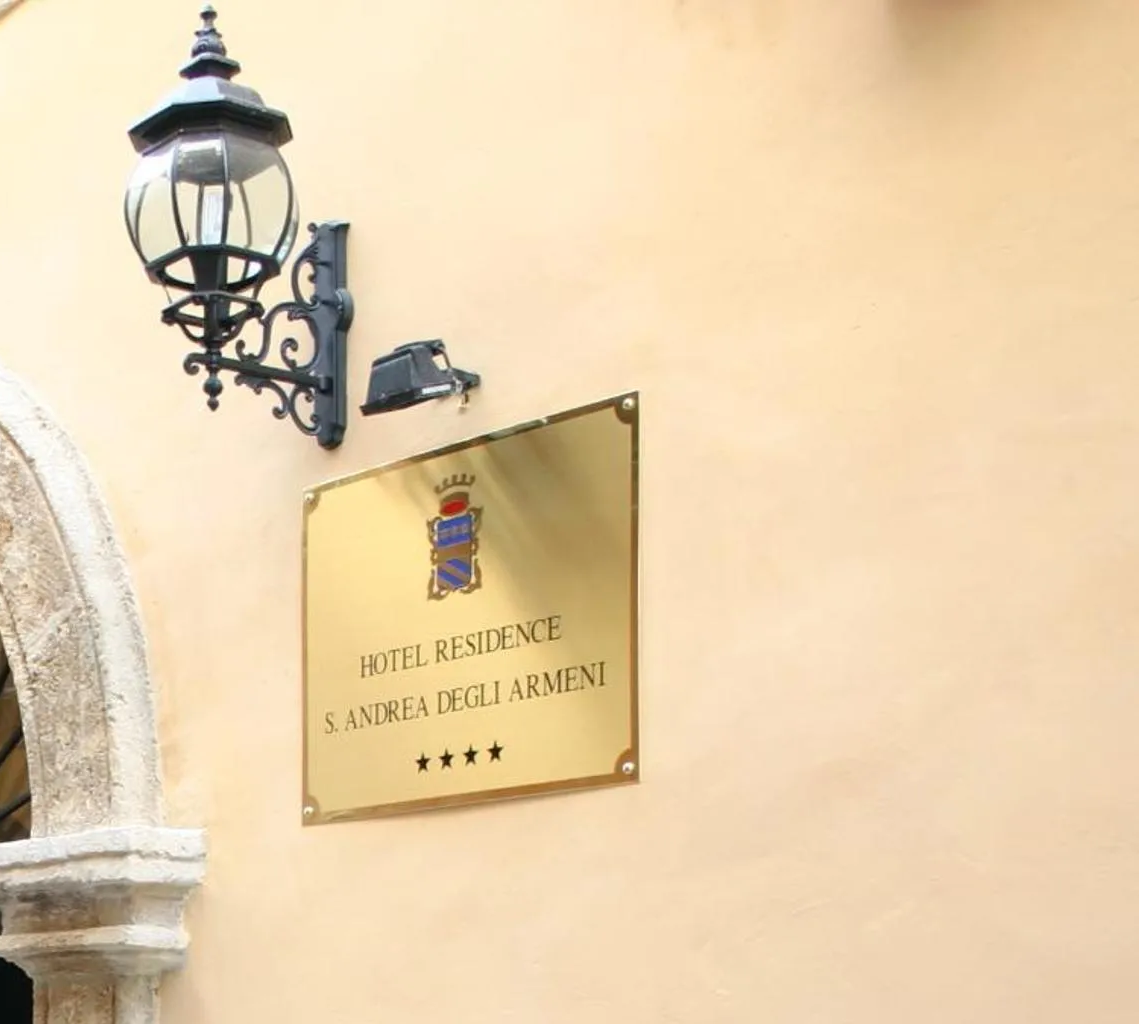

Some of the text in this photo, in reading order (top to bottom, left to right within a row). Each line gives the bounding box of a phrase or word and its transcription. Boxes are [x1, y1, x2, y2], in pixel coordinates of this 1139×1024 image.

[360, 615, 562, 679] HOTEL RESIDENCE
[324, 661, 606, 734] S. ANDREA DEGLI ARMENI
